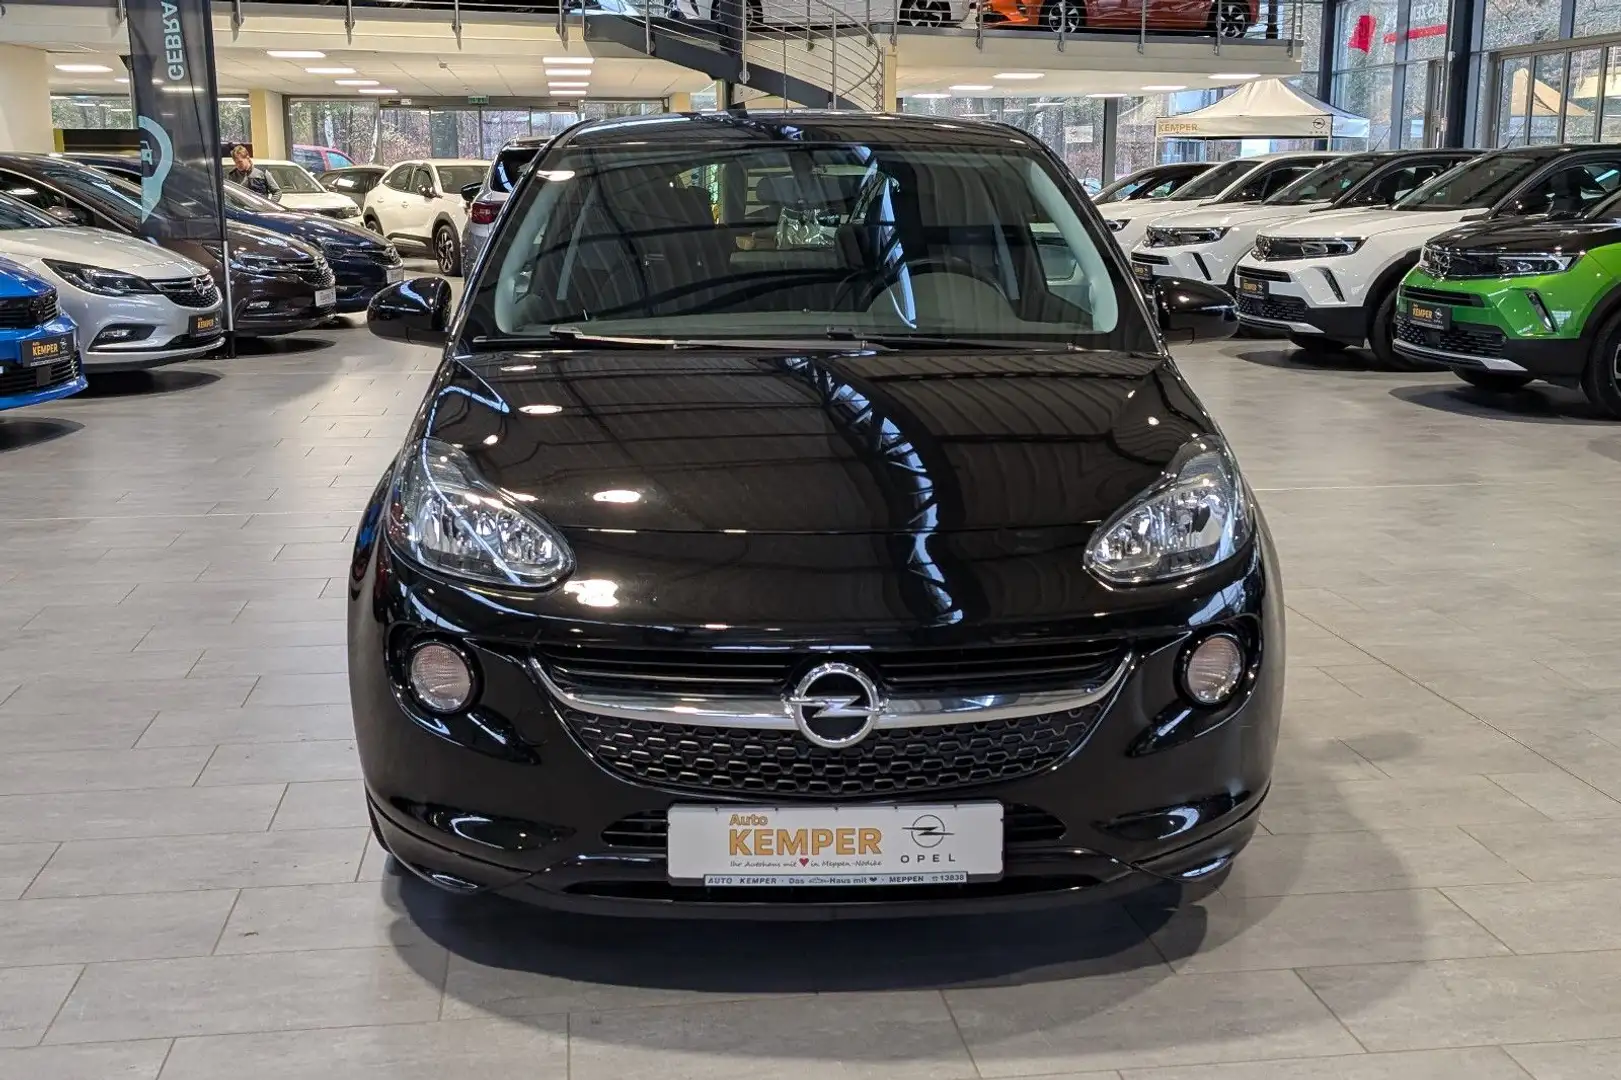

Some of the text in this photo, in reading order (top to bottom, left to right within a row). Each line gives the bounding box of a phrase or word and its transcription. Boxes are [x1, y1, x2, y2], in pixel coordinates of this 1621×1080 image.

[1158, 123, 1199, 132] KEMPER
[32, 343, 58, 356] KEMPER
[729, 814, 768, 826] Auto
[729, 828, 882, 856] KEMPER
[900, 853, 956, 863] OPEL
[708, 877, 733, 885] AUTO
[739, 877, 777, 885] KEMPER
[788, 877, 805, 885] Das
[853, 876, 868, 884] mit
[889, 875, 924, 883] MEPPEN
